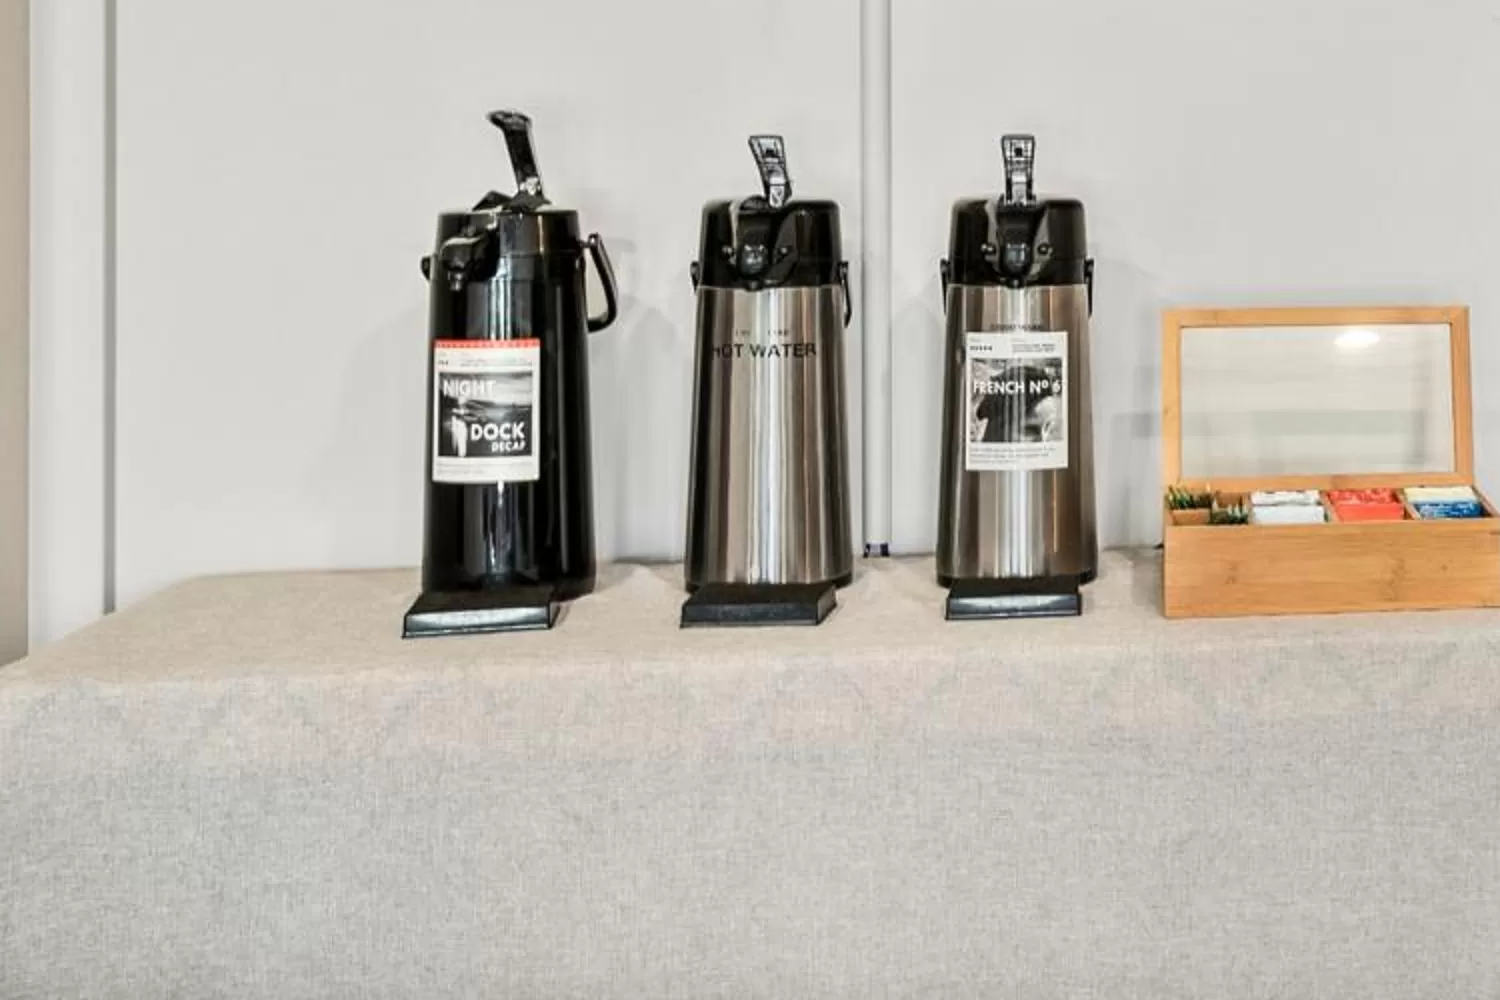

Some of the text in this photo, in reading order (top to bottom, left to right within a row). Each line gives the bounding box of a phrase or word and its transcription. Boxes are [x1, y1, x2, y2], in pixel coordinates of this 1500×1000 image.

[749, 343, 817, 358] WATER
[443, 379, 496, 397] NIGHT
[973, 380, 1025, 395] FRENCH
[1052, 379, 1061, 394] 6
[470, 422, 525, 440] DOCK
